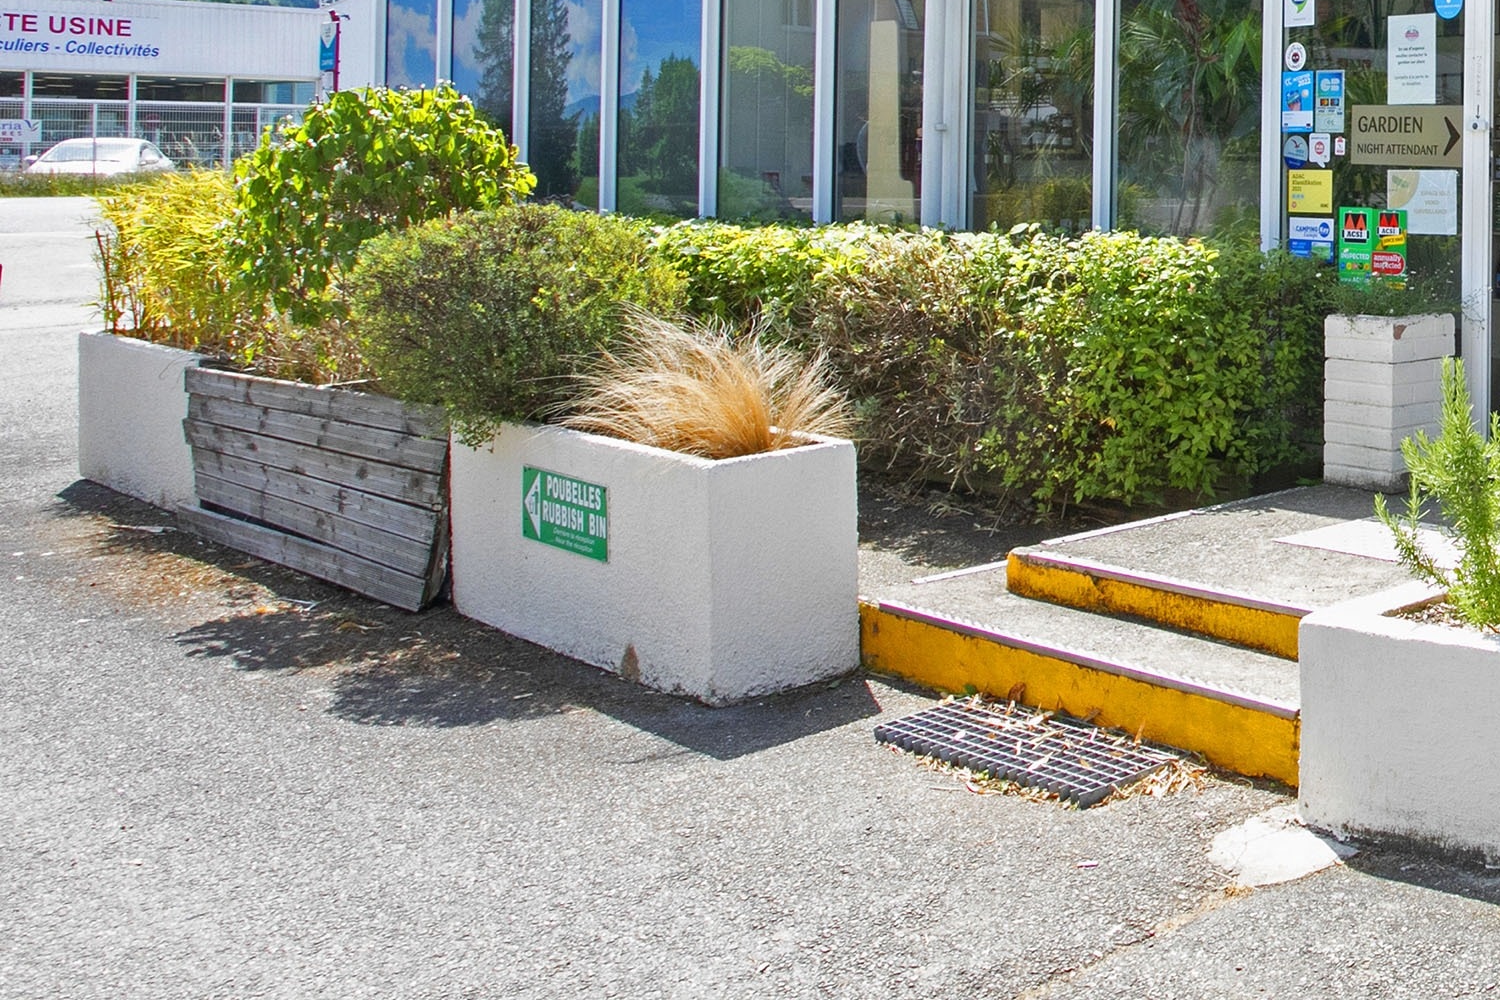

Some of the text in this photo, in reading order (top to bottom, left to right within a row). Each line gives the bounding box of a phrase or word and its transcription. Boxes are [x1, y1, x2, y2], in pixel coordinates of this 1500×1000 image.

[0, 12, 132, 38] TE USINE
[65, 40, 160, 57] Collectivités
[0, 120, 22, 130] ria
[1358, 116, 1423, 133] GARDIEN
[1357, 143, 1438, 156] NIGHT ATTENDANT
[1296, 225, 1318, 233] CAMPING
[1373, 255, 1401, 263] annually
[547, 474, 601, 511] POUBELLES
[541, 500, 584, 533] RUBBISH
[589, 513, 606, 539] BIN
